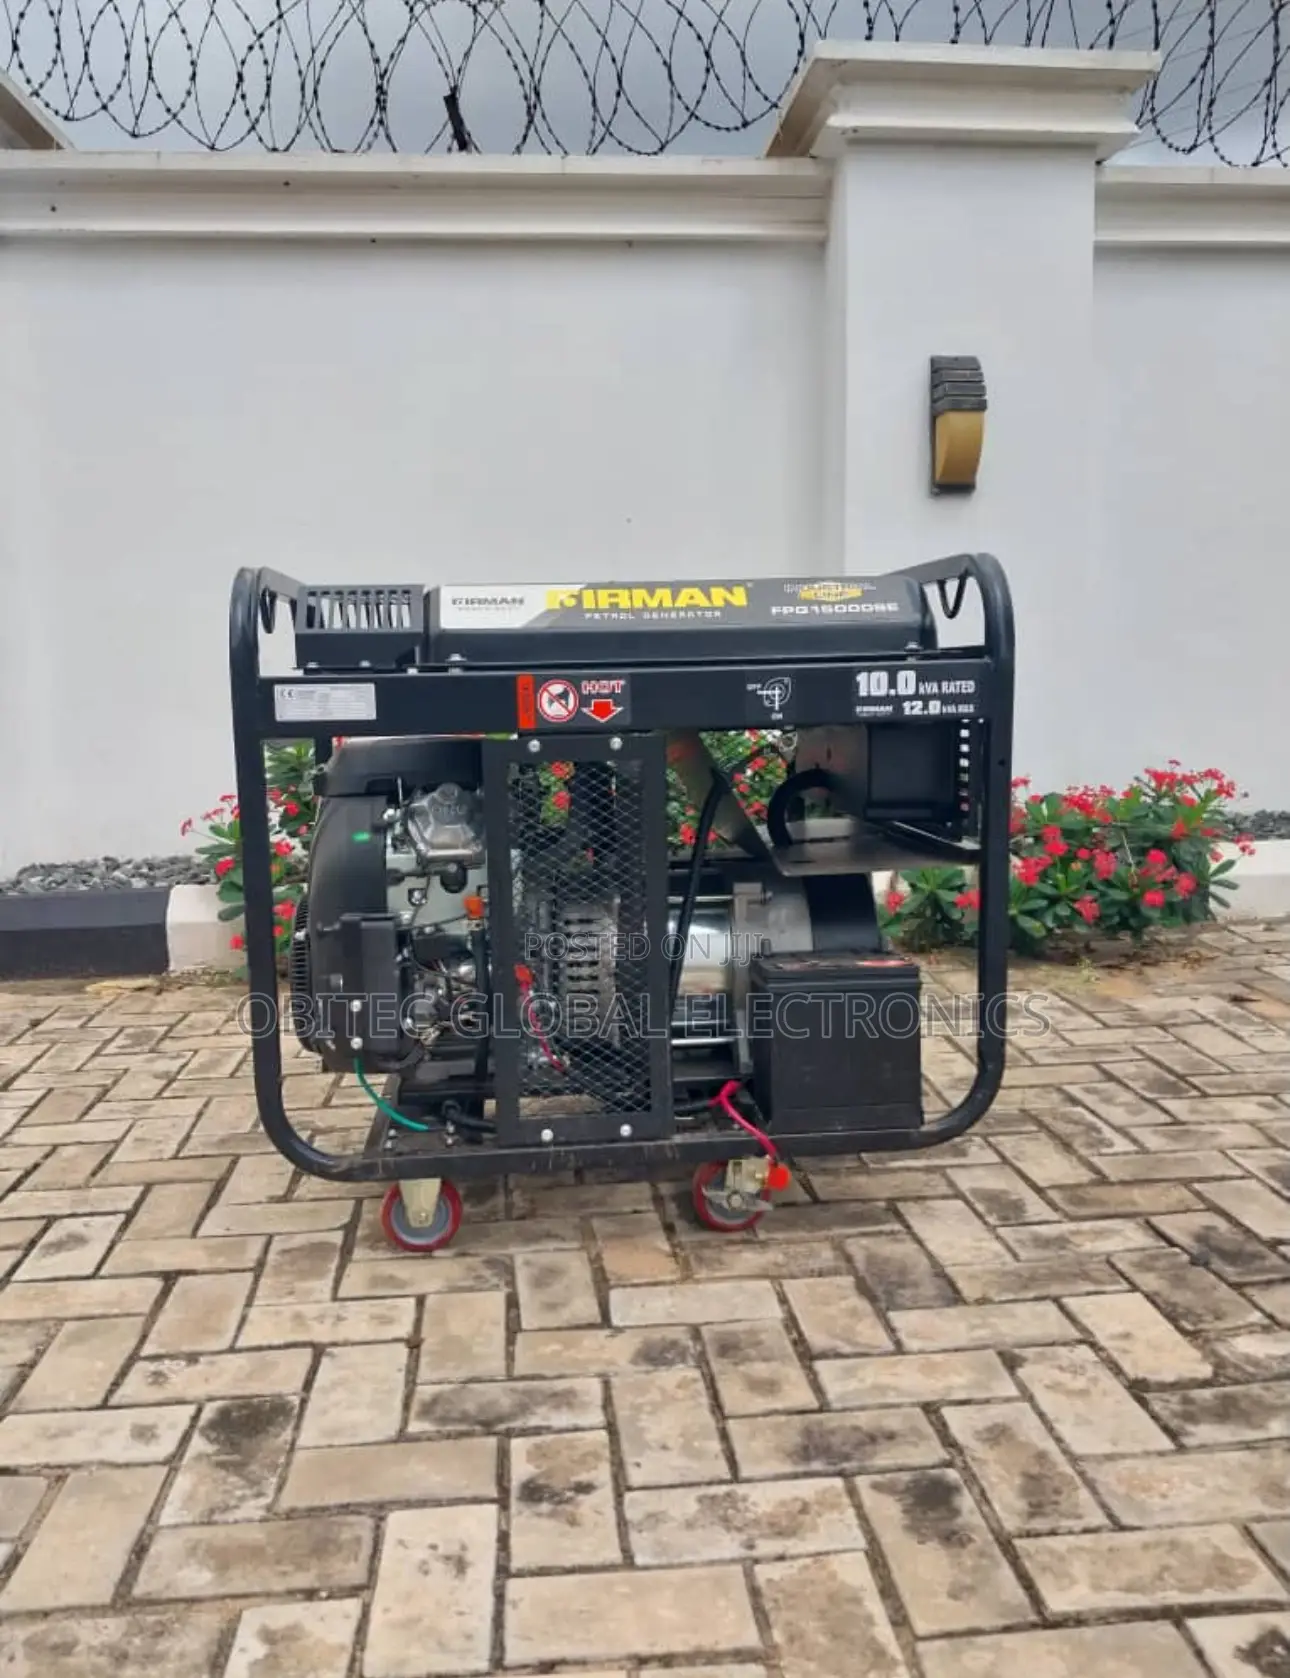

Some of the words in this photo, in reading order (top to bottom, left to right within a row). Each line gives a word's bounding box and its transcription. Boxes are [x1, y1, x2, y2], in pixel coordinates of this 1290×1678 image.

[546, 586, 748, 610] FIRMAN
[581, 679, 626, 695] HOT
[856, 670, 917, 697] 10.0
[941, 680, 976, 694] RATED
[902, 700, 941, 716] 12.0
